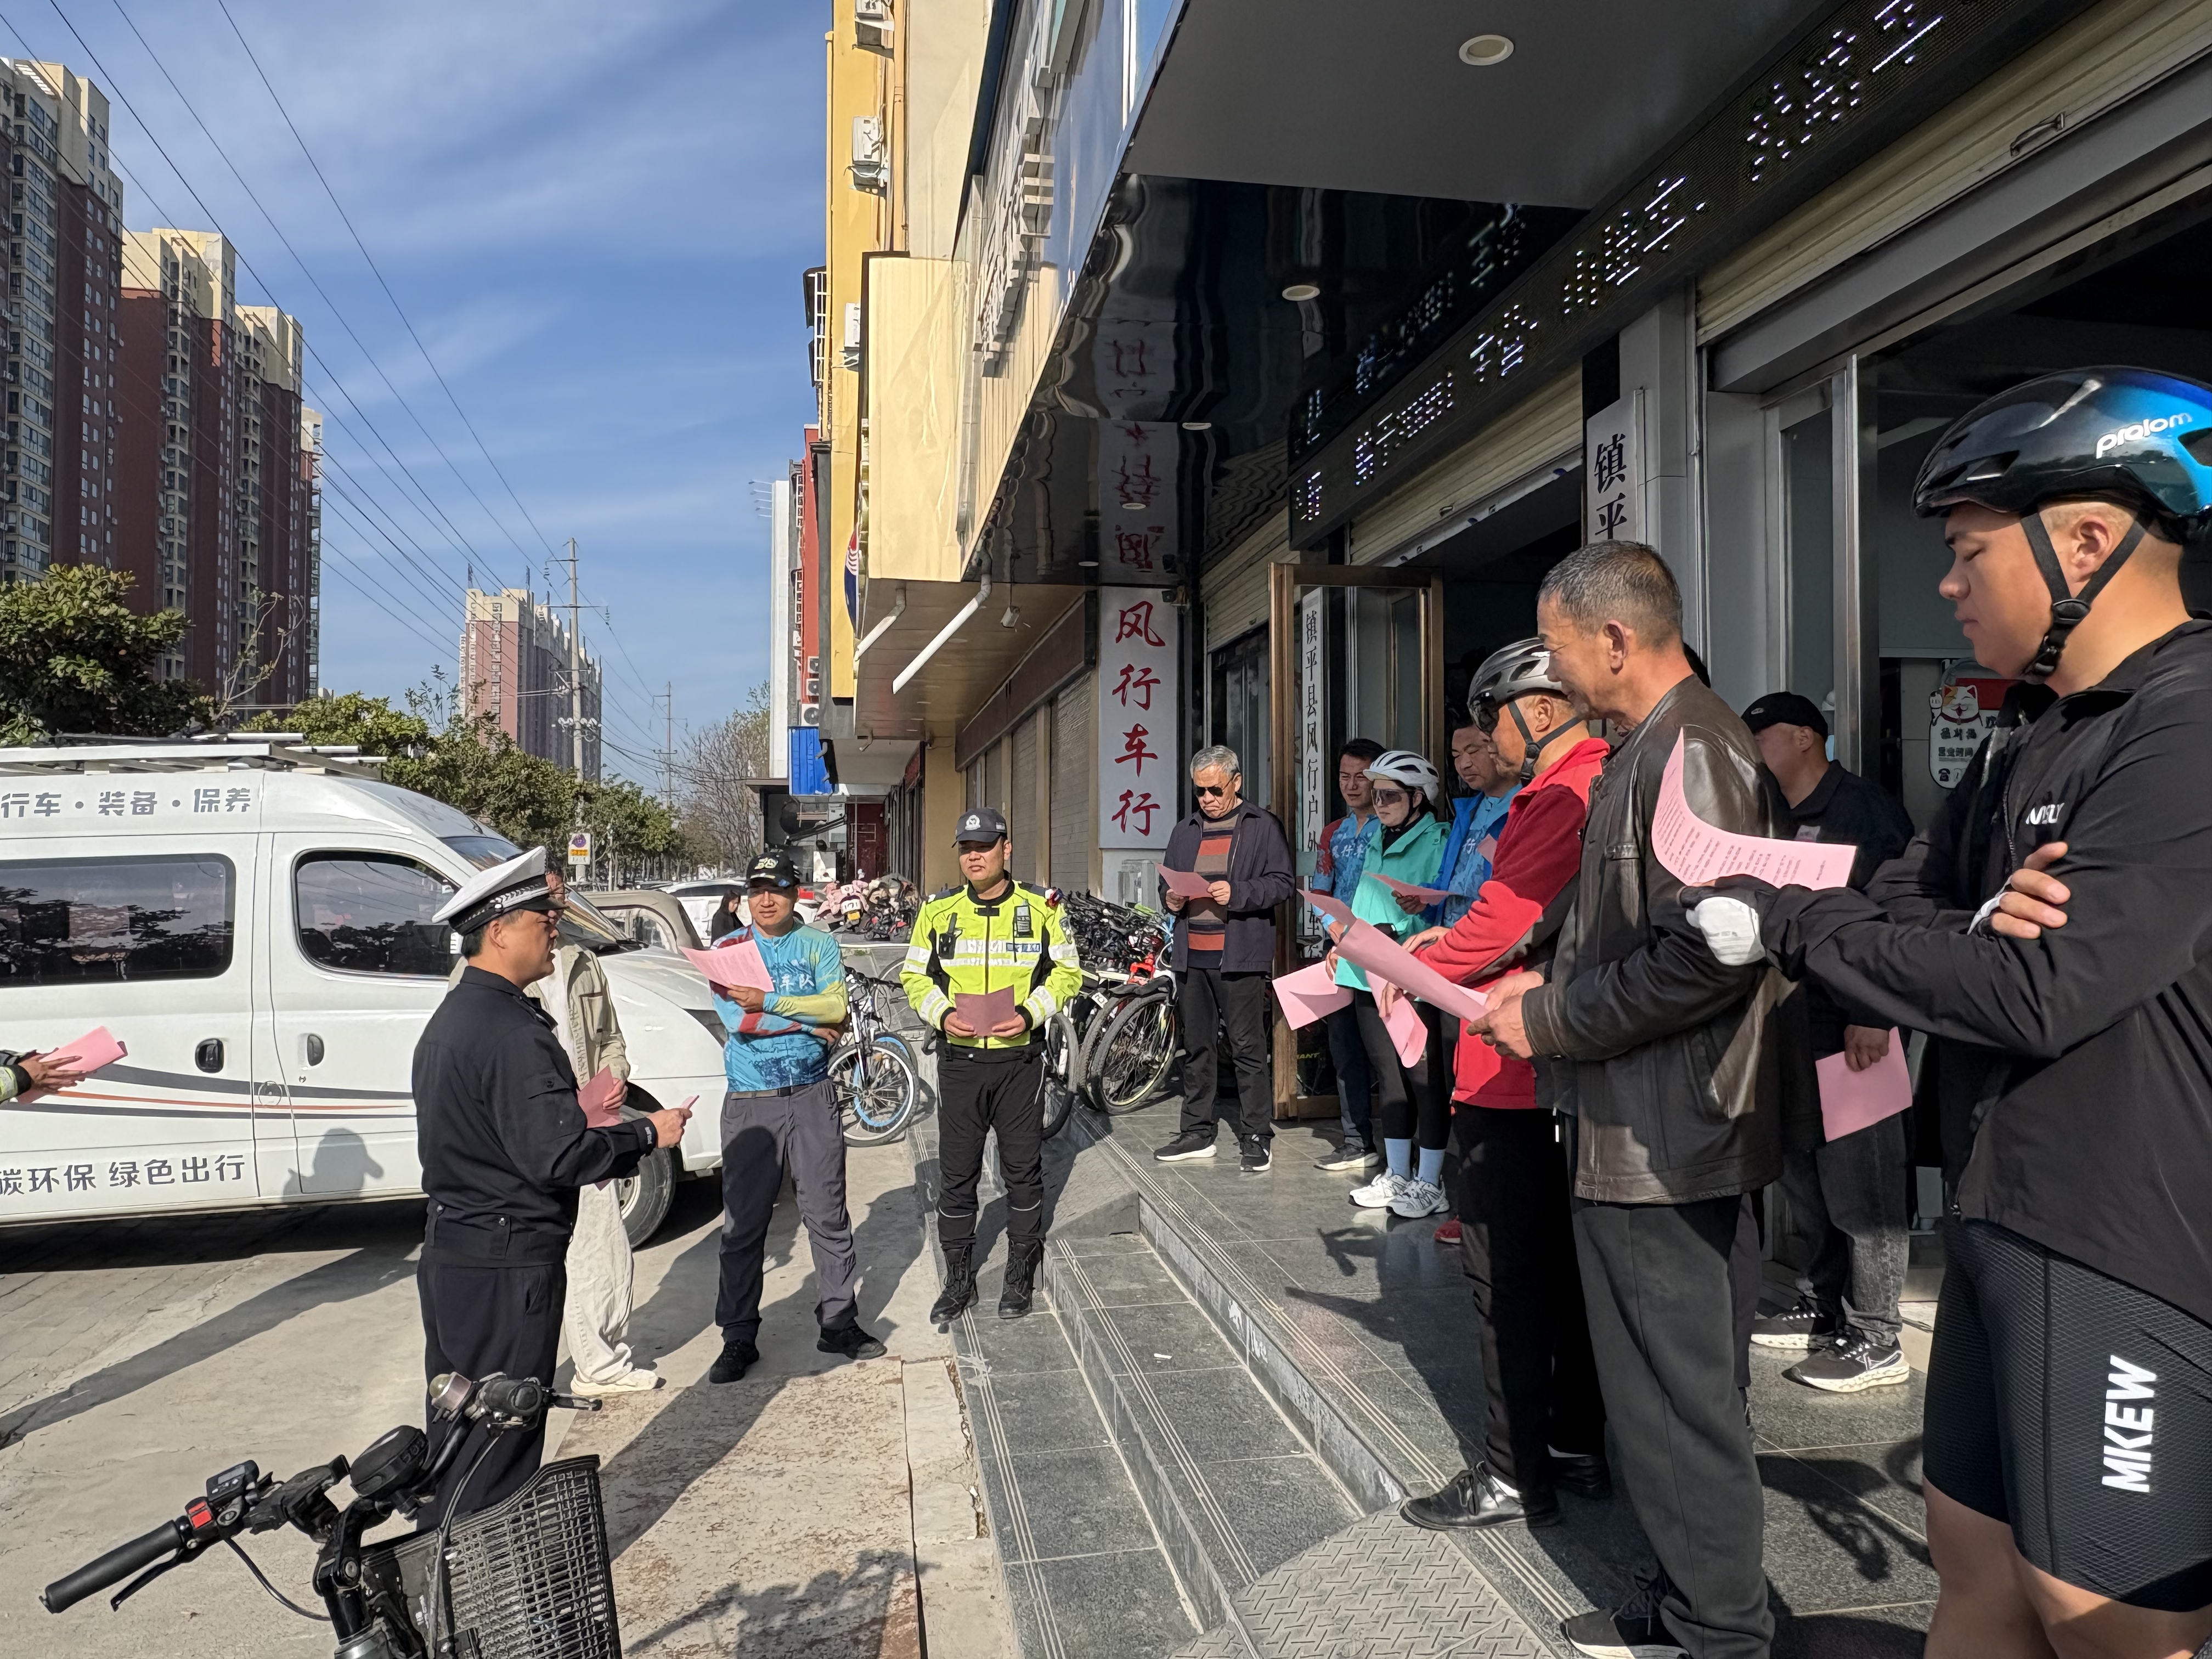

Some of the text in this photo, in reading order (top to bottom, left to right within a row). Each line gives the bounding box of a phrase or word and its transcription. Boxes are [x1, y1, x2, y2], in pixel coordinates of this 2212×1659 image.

[1593, 433, 1628, 540] 镇平
[1110, 600, 1166, 837] 风行车行
[109, 1154, 245, 1188] 绿色出行
[2101, 1355, 2157, 1493] MKEW
